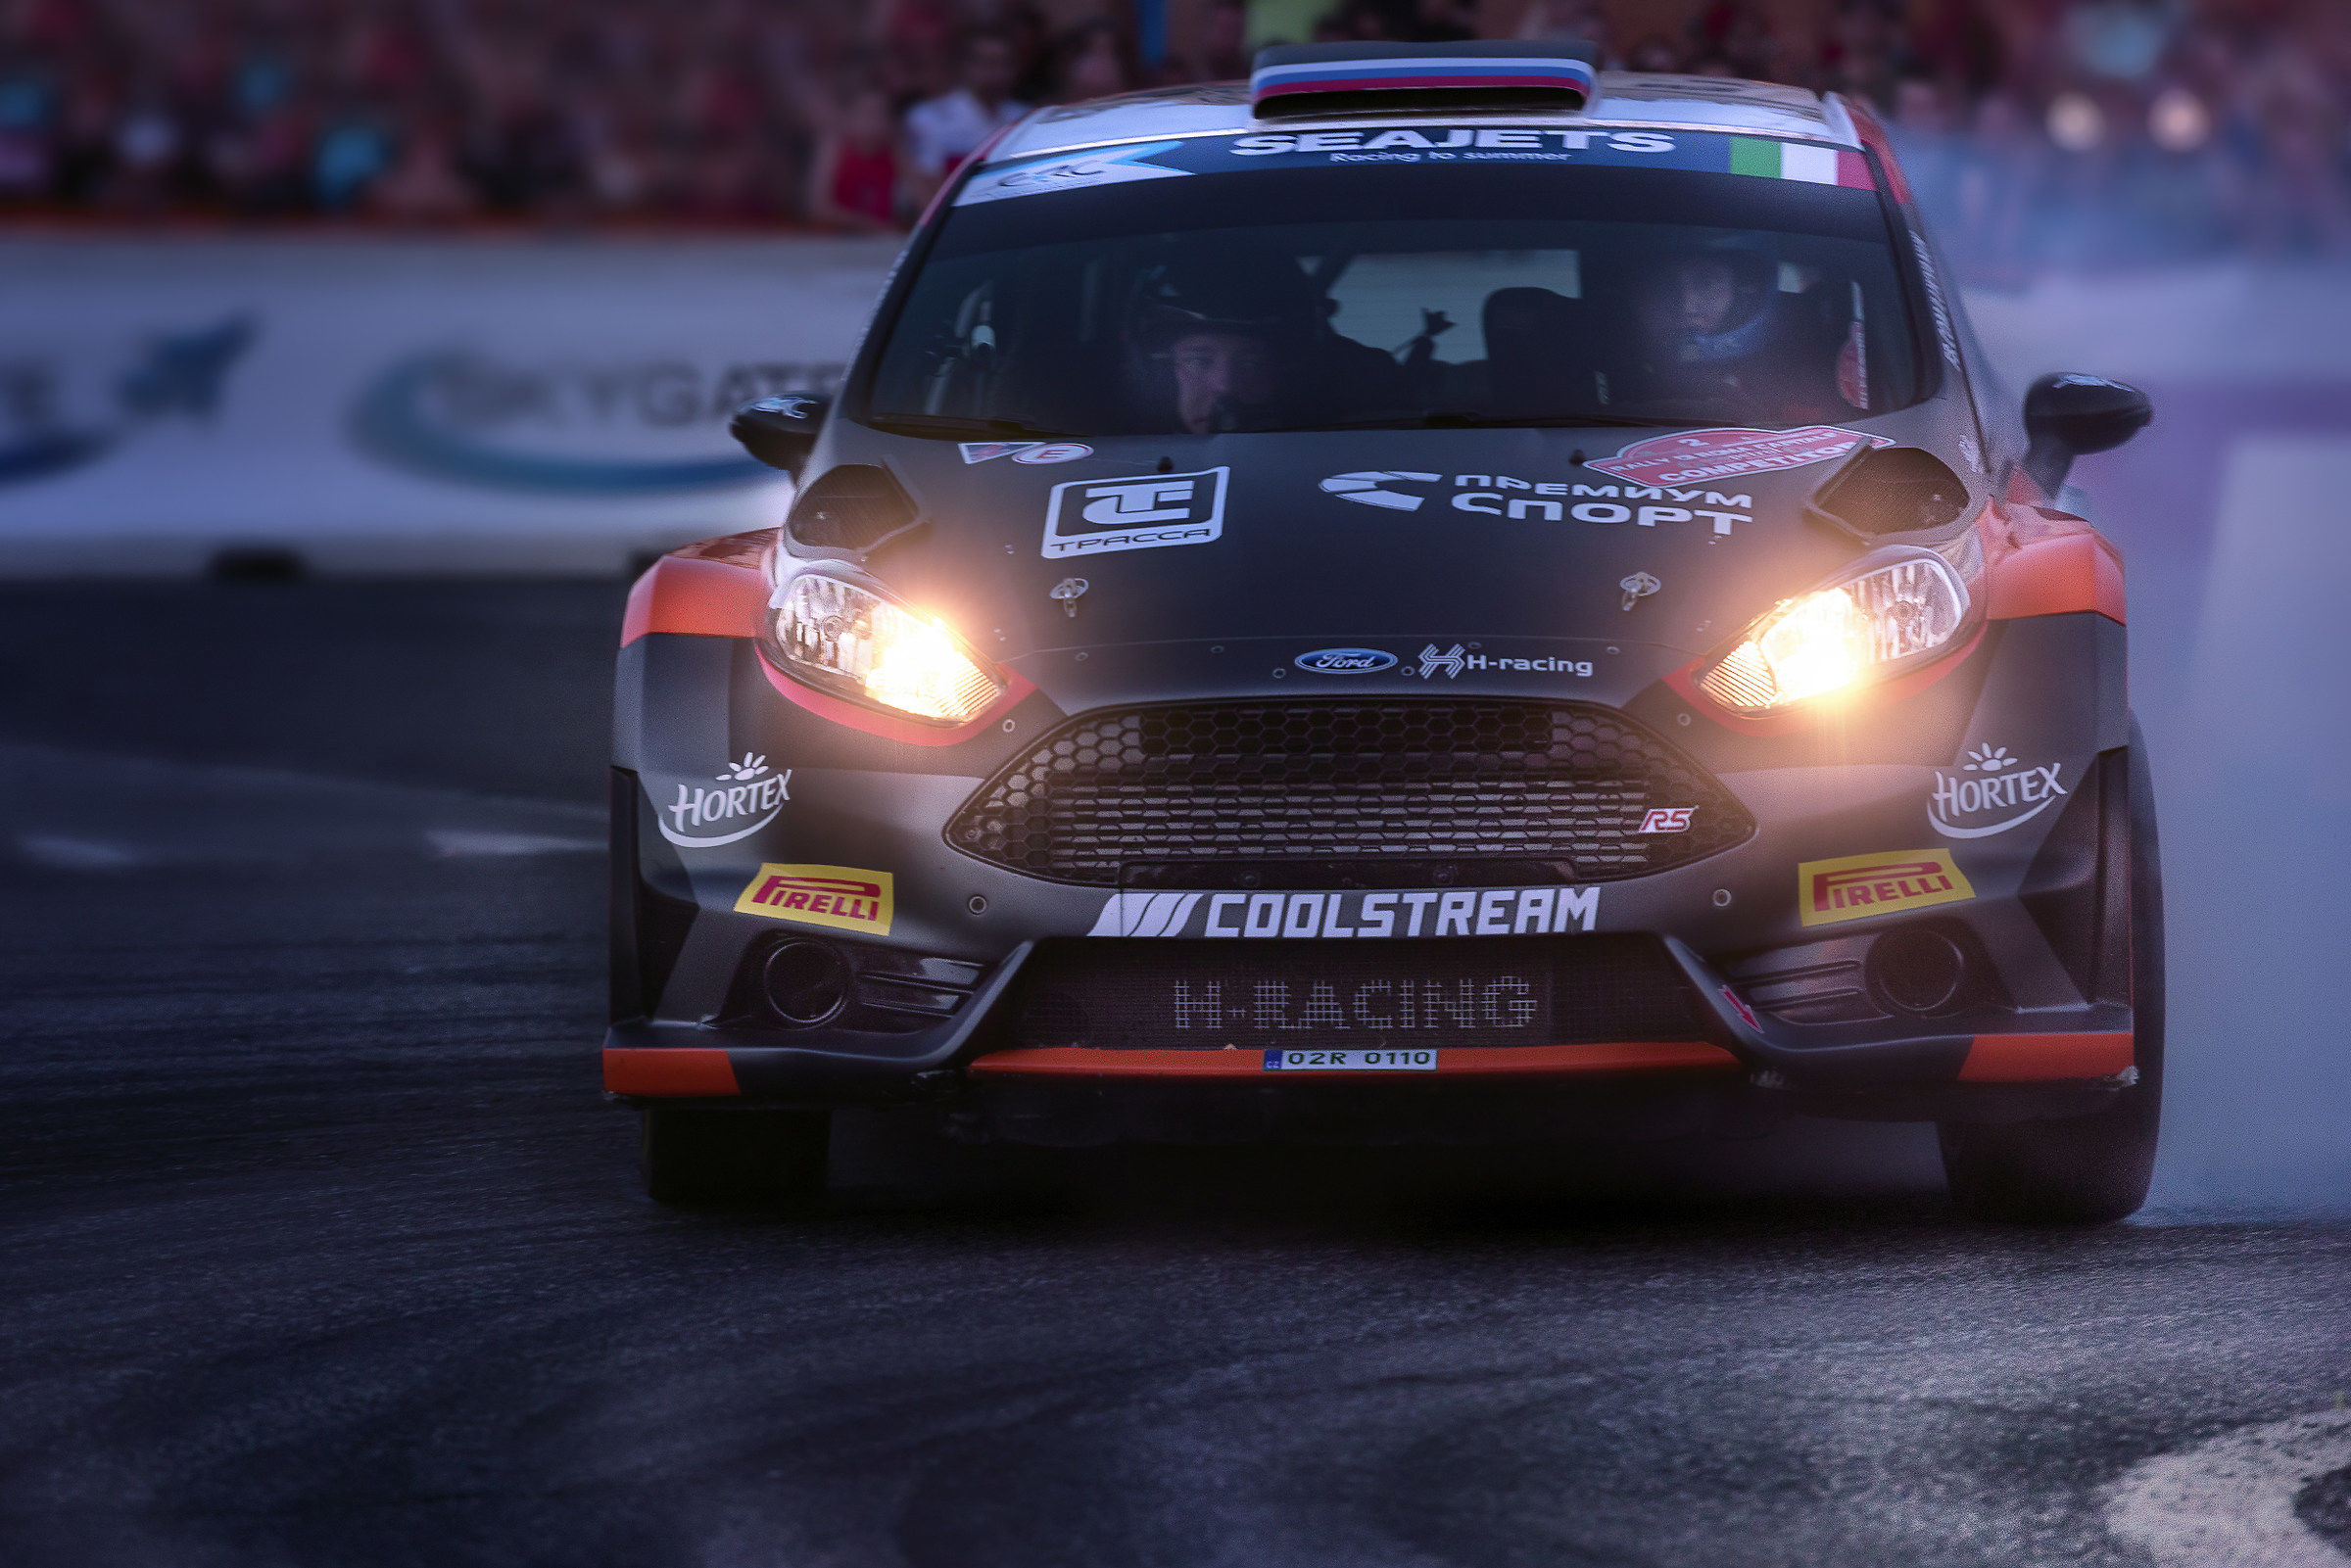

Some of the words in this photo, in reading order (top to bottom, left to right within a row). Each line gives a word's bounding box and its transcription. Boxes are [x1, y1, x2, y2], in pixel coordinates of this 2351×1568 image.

[1229, 129, 1676, 156] SEAJETS
[1035, 449, 1072, 459] E
[1454, 474, 1752, 508] ПРЕМИУМ
[1451, 492, 1753, 536] СПОРТ
[1049, 528, 1212, 552] ТРАССА
[1316, 652, 1377, 669] Ford
[1467, 654, 1594, 678] H-racing
[667, 769, 792, 832] HORTEX
[1931, 762, 2069, 822] HORTEX
[1640, 808, 1693, 832] RS
[751, 875, 882, 922] PIRELLI
[1812, 861, 1954, 912] PIRELLI
[1204, 886, 1602, 938] COOLSTREAM
[1174, 975, 1538, 1029] H-RACING
[1288, 1052, 1347, 1065] 02R
[1365, 1051, 1430, 1065] 0110
